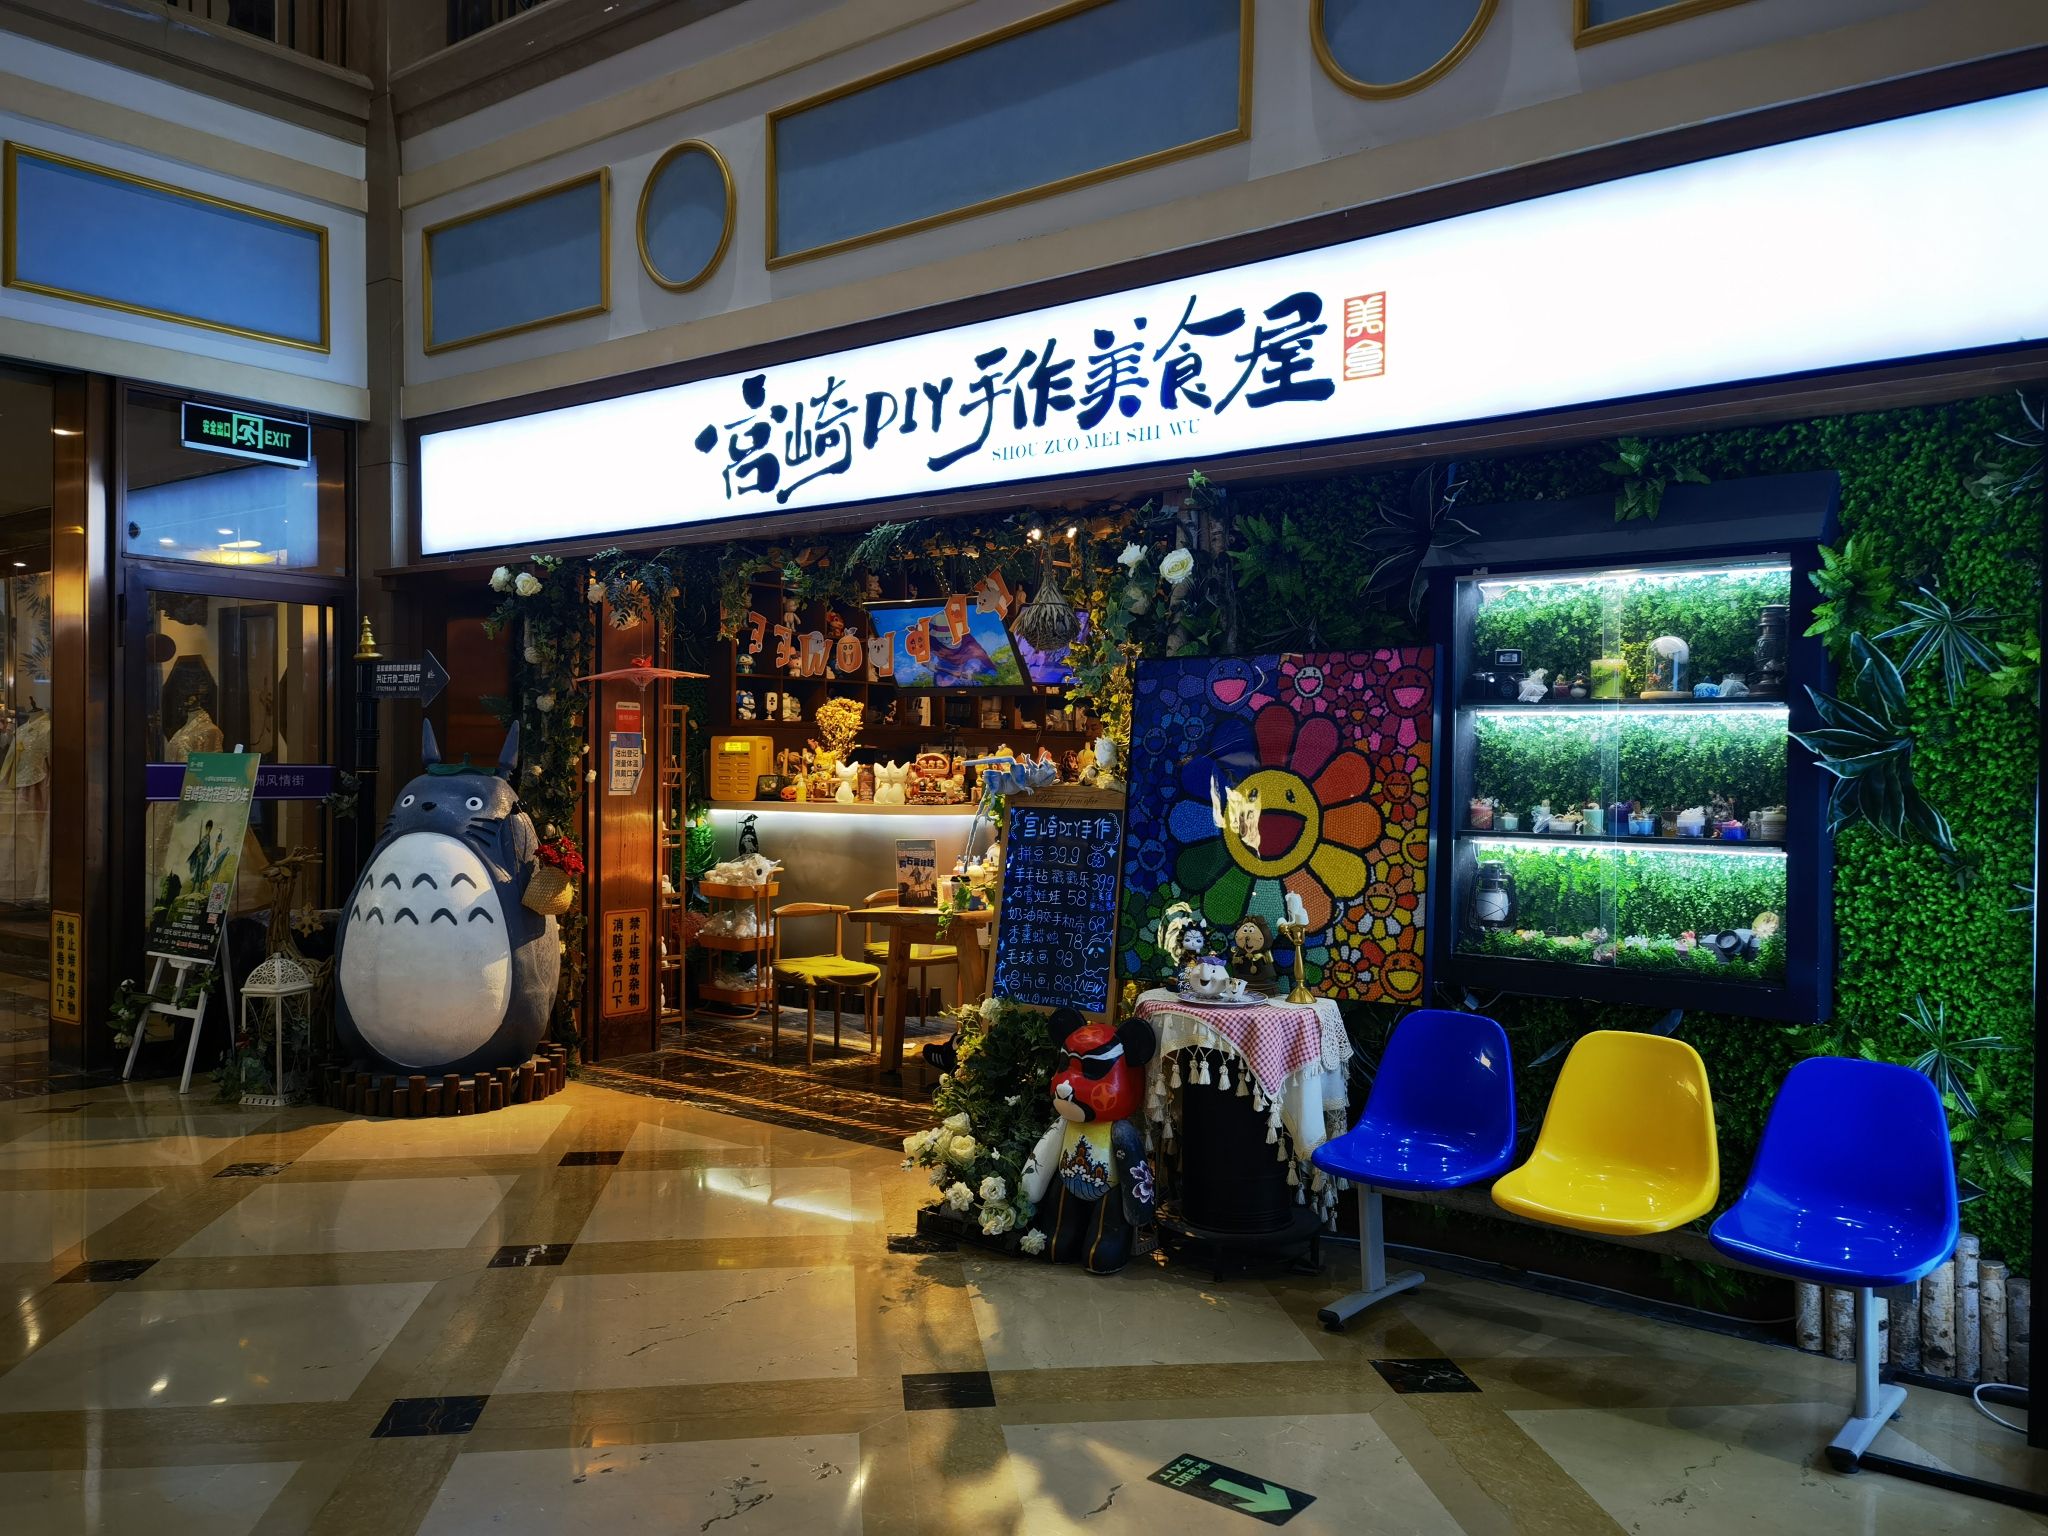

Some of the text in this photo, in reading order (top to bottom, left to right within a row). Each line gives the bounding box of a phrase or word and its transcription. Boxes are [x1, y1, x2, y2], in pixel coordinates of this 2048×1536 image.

[202, 419, 231, 438] 安全出口
[264, 429, 291, 449] EXIT
[992, 418, 1202, 462] SHOU ZUO MEI SHI WU
[614, 749, 639, 758] 进出登记
[614, 759, 639, 768] 测量体温
[614, 769, 639, 778] 佩戴口罩
[1023, 811, 1112, 840] 宫崎DIY手作
[1018, 844, 1081, 864] 拼豆 39.9
[1011, 884, 1062, 905] 石膏娃娃
[1067, 889, 1087, 907] 58
[1007, 905, 1106, 935] 奶油胶手机壳 68
[1008, 923, 1083, 950] 香薰蜡烛 78
[56, 919, 65, 1013] 消防卷帘门下
[67, 921, 76, 1016] 禁止堆放杂物
[612, 917, 624, 1009] 消防卷帘门下
[628, 916, 641, 1007] 禁止堆放杂物
[1005, 948, 1074, 968] 毛球画 98
[1005, 969, 1073, 992] 唱片画 88
[1078, 979, 1102, 994] NEW
[1159, 1458, 1195, 1480] EXIT
[1170, 1462, 1211, 1487] 安全出口
